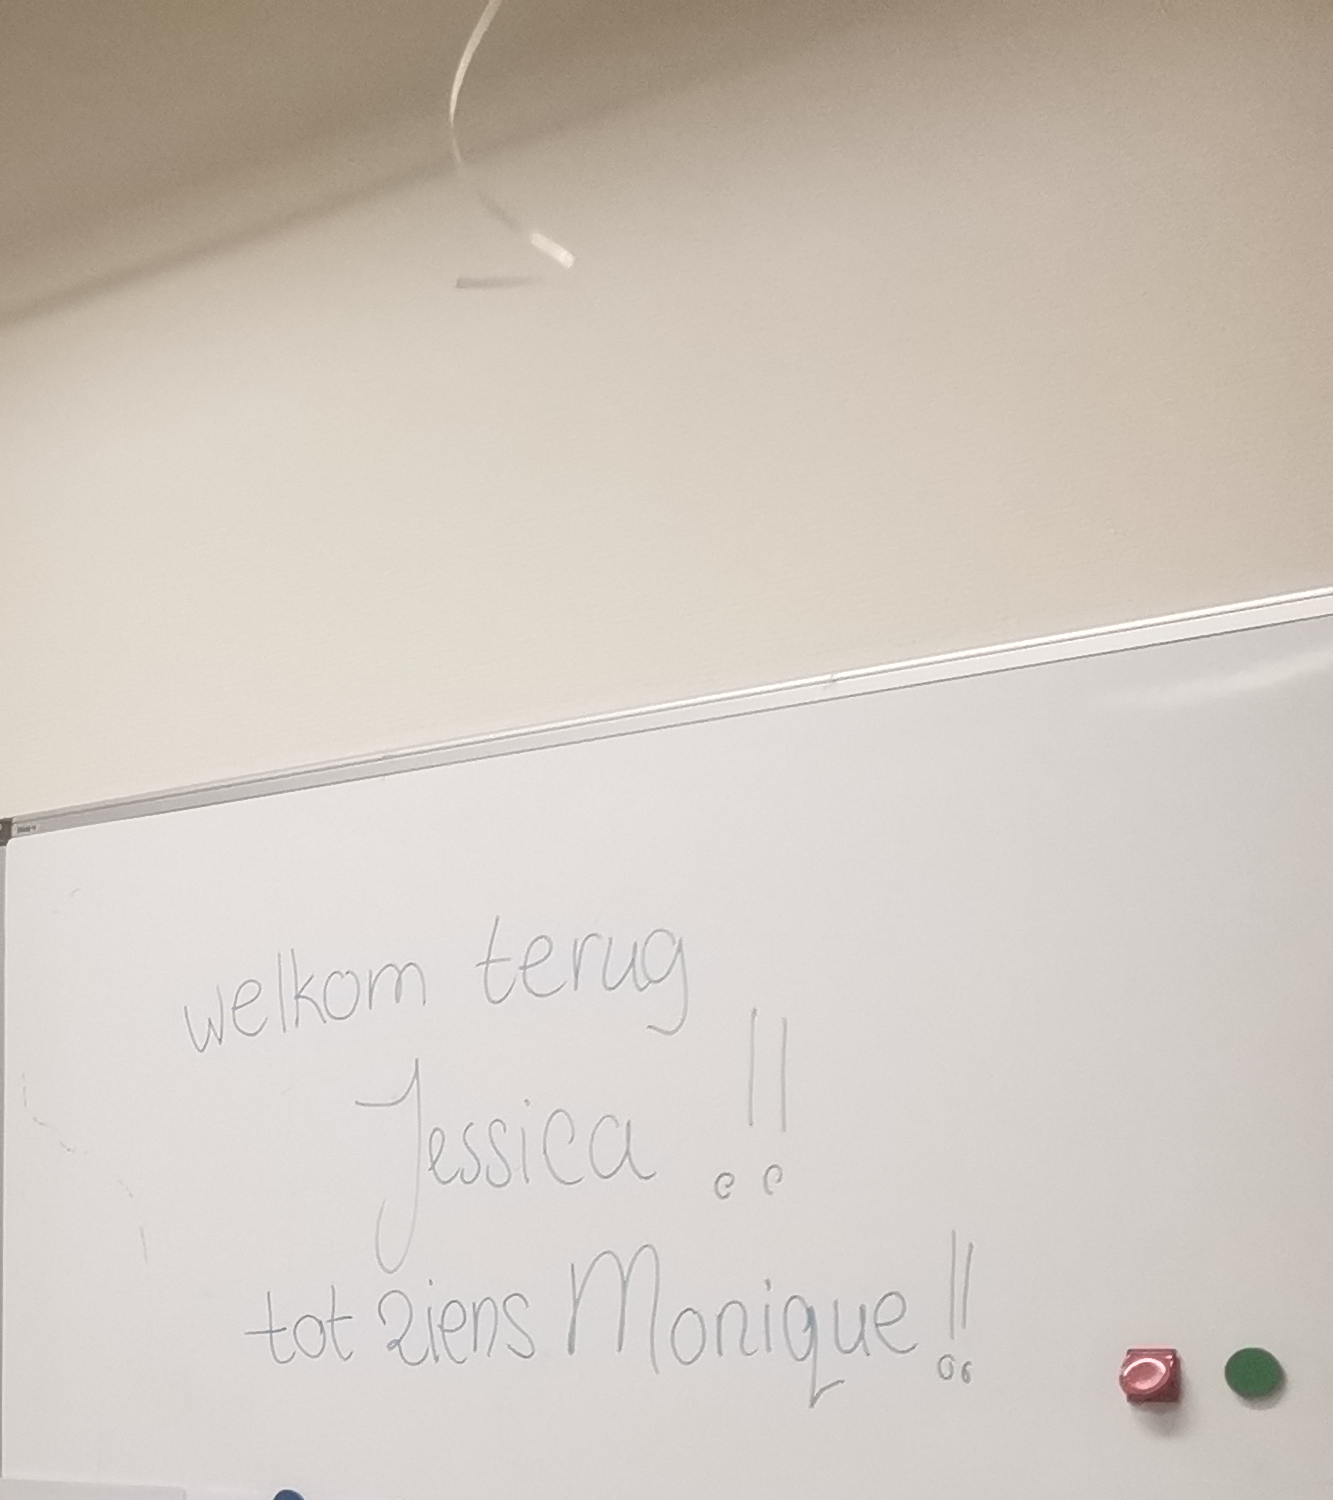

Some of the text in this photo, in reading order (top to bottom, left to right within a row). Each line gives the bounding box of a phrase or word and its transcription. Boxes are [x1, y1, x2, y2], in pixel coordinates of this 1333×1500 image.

[184, 914, 690, 1054] welkom terug
[354, 1057, 658, 1275] Jessica
[244, 1284, 354, 1365] tot
